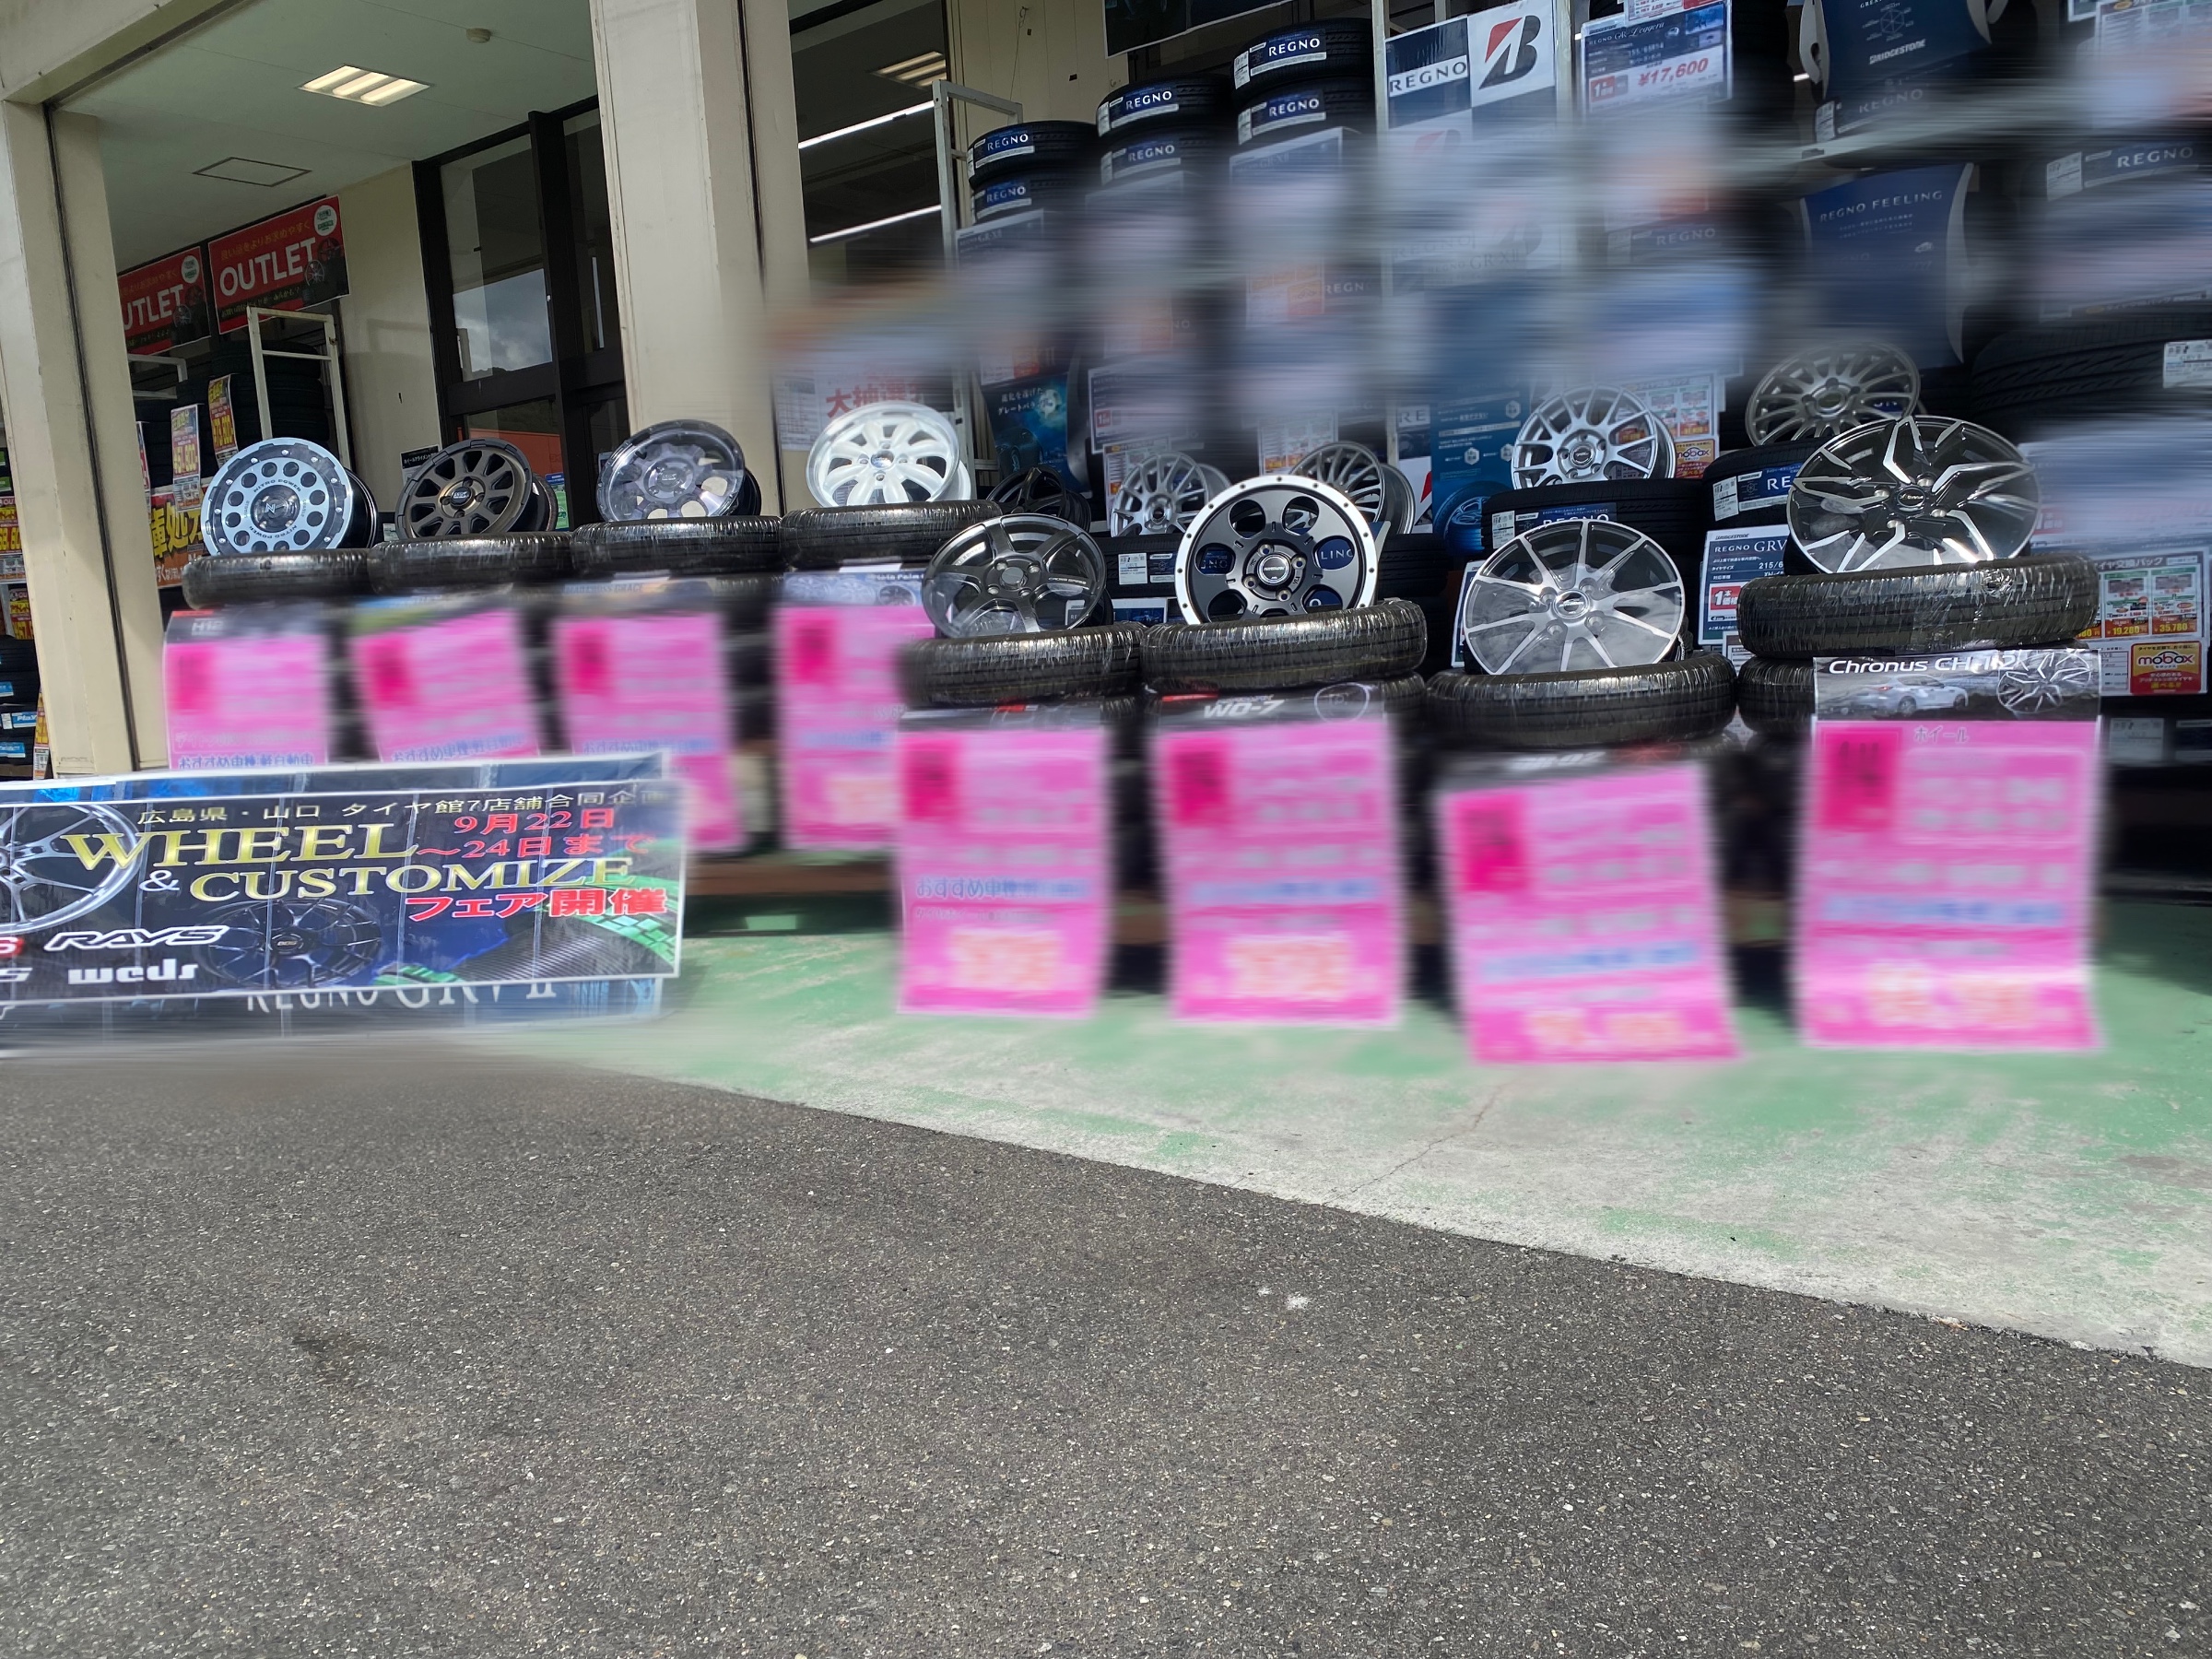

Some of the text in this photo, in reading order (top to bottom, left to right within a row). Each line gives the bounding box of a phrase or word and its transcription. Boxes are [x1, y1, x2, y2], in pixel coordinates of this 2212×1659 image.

[1268, 38, 1321, 57] REGNO
[1869, 39, 1926, 65] BRIDGESTONE
[1389, 61, 1467, 92] REGNO
[1638, 57, 1710, 88] ¥17,600
[1125, 90, 1172, 111] REGNO
[1268, 98, 1320, 117] REGNO
[987, 133, 1029, 151] REGNO
[1127, 145, 1175, 162] REGNO
[2117, 147, 2194, 169] REGNO
[986, 185, 1027, 204] REGNO
[1819, 190, 1943, 224] REGNO FEELING
[1655, 227, 1717, 246] REGNO
[219, 237, 316, 297] OUTLET
[1324, 280, 1371, 294] REGN
[253, 478, 301, 493] NITRO POWER
[1767, 476, 1792, 490] RE
[1714, 545, 1750, 553] REGNO
[1829, 658, 1928, 675] Chronus
[2138, 653, 2194, 665] mobox
[1914, 724, 1969, 744] ホイール
[137, 805, 320, 825] 広島県・山口
[453, 807, 616, 835] 9月22日
[60, 822, 419, 871] WHEEL
[139, 857, 637, 902] & CUSTOMIZE
[406, 887, 668, 923] フェア開催
[44, 924, 230, 952] RAYS
[67, 958, 199, 985] weds
